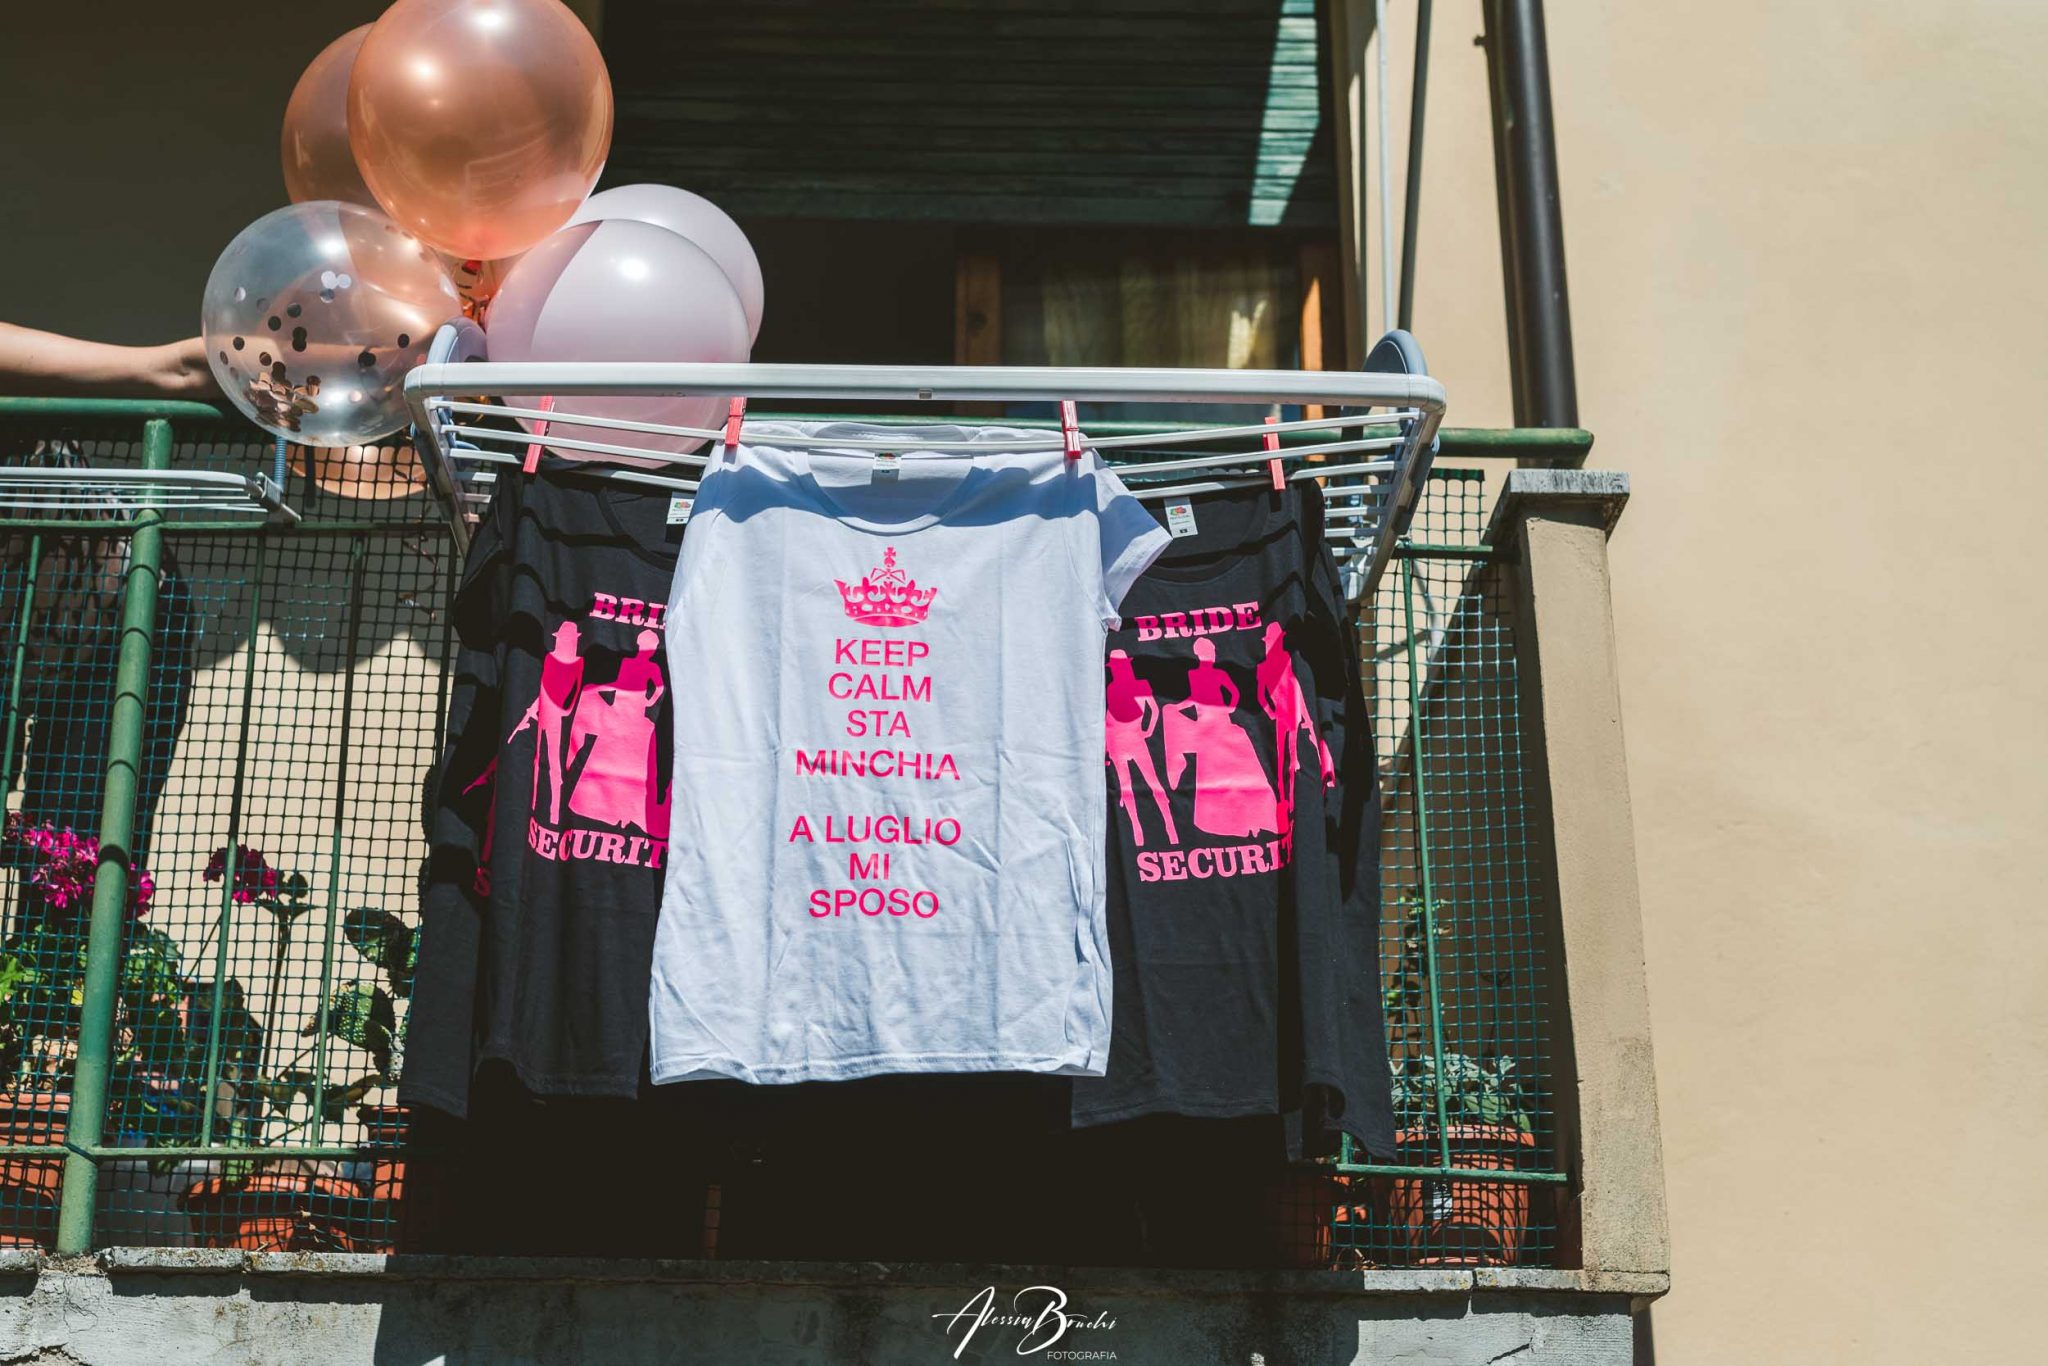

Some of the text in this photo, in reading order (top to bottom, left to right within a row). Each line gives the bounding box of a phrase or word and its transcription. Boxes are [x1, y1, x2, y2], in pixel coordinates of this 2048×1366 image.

[589, 592, 668, 630] BRI
[1134, 601, 1264, 642] BRIDE
[835, 638, 930, 667] KEEP
[828, 672, 932, 702] CALM
[846, 709, 911, 738] STA
[795, 749, 961, 781] MINCHIA
[528, 816, 669, 869] SECURIT
[789, 815, 962, 846] A LUGLIO
[849, 853, 890, 881] MI
[1136, 834, 1294, 882] SECURIT
[808, 888, 940, 919] SPOSO
